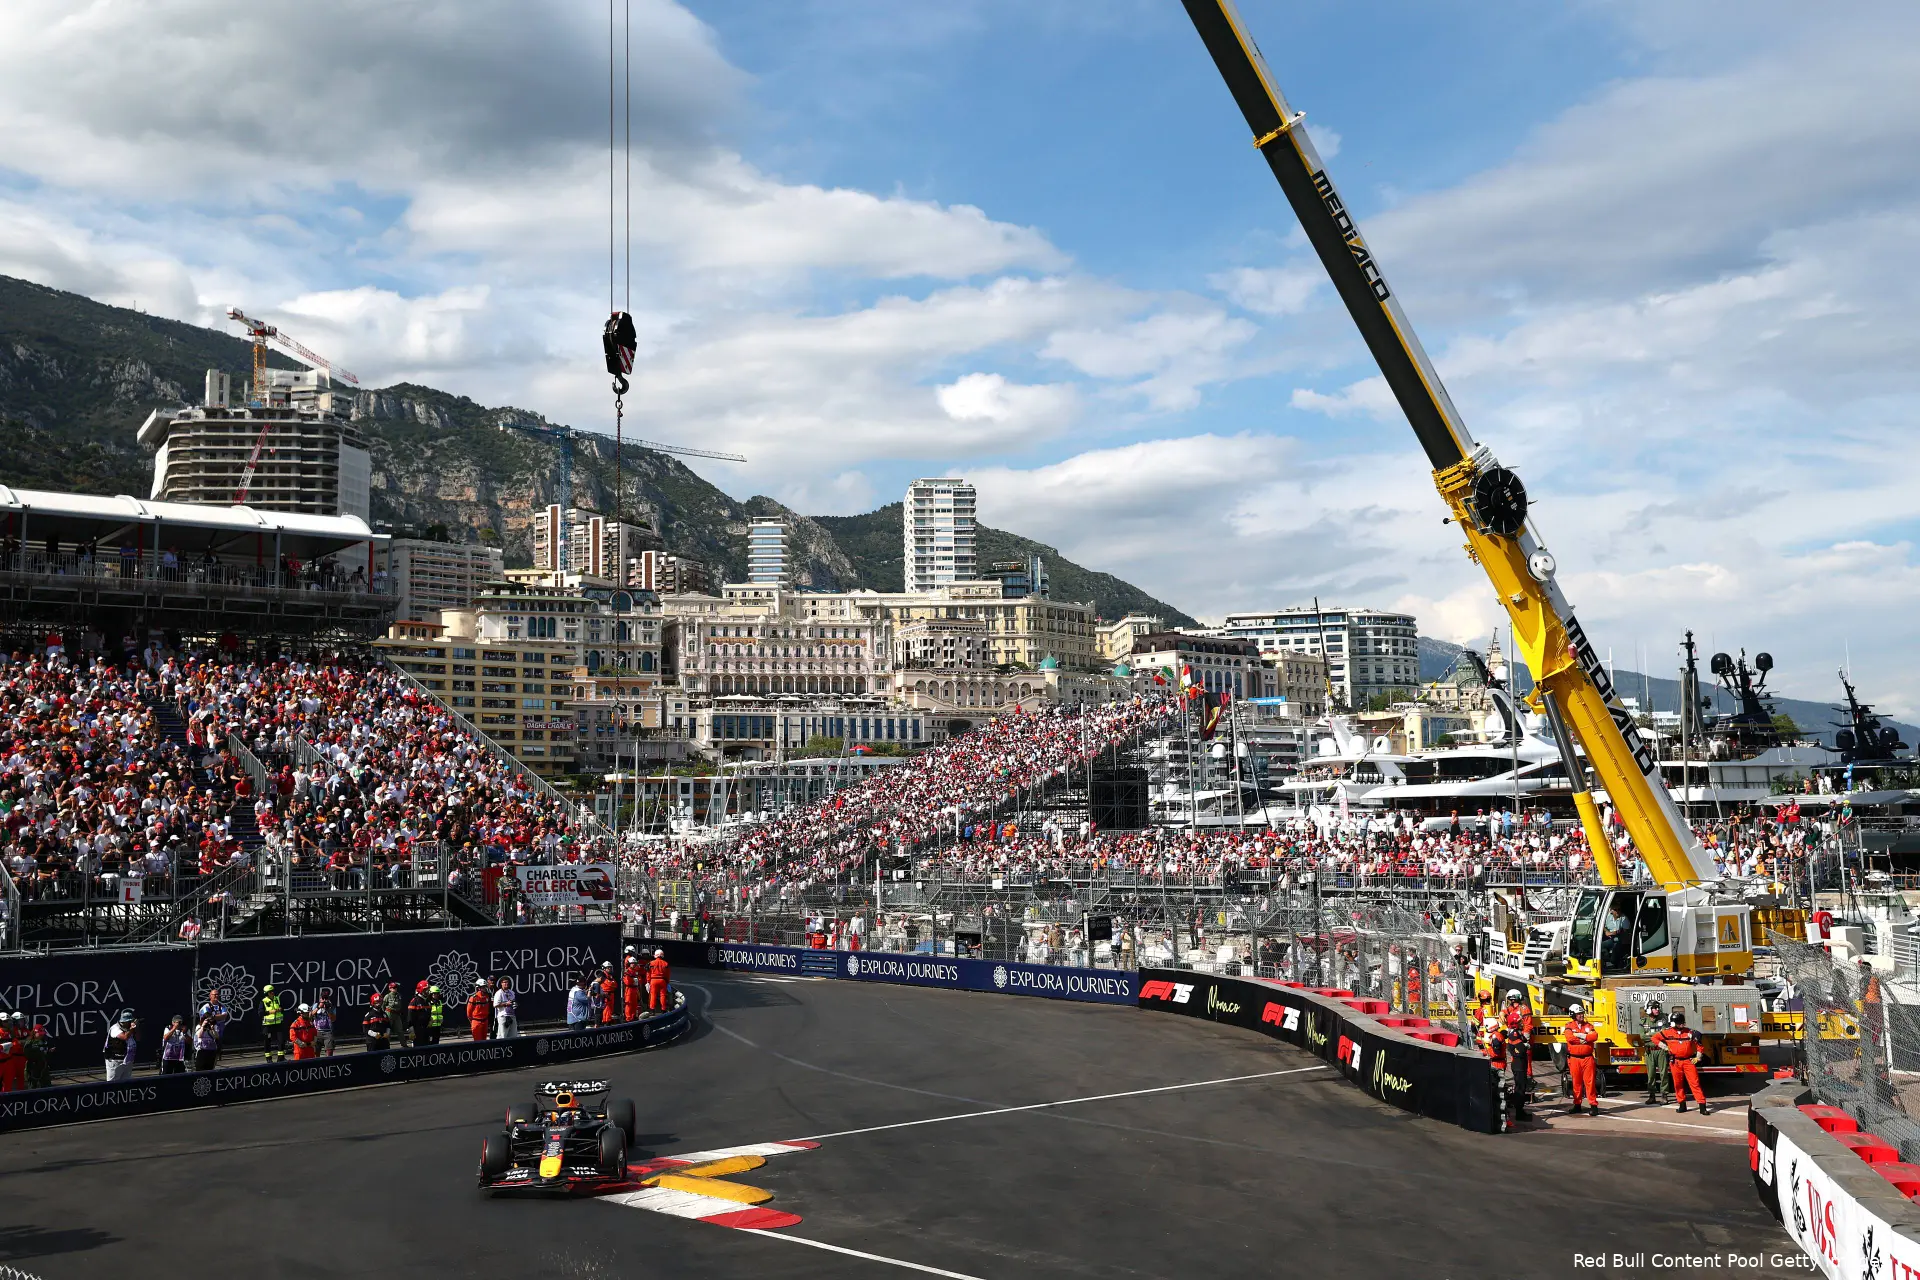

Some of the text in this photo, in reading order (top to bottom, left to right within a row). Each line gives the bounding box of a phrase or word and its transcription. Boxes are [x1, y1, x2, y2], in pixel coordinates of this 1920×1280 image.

[526, 869, 577, 880] CHARLES
[125, 887, 136, 901] L
[490, 945, 597, 971] EXPLORA
[718, 949, 797, 968] EXPLORA JOURNEYS
[269, 957, 392, 985] EXPLORA
[861, 960, 958, 980] EXPLORA JOURNEYS
[1010, 970, 1130, 996] EXPLORA JOURNEYS
[1207, 984, 1241, 1015] Monaco
[1632, 992, 1642, 1002] 60
[1645, 992, 1654, 1001] 70
[1656, 992, 1665, 1002] 80
[551, 1029, 634, 1052] EXPLORA JOURNEYS
[400, 1045, 513, 1069] EXPLORA JOURNEYS
[216, 1063, 352, 1092] EXPLORA JOURNEYS
[1373, 1049, 1412, 1100] Monaco
[0, 1086, 157, 1118] XPLORA JOURNEYS
